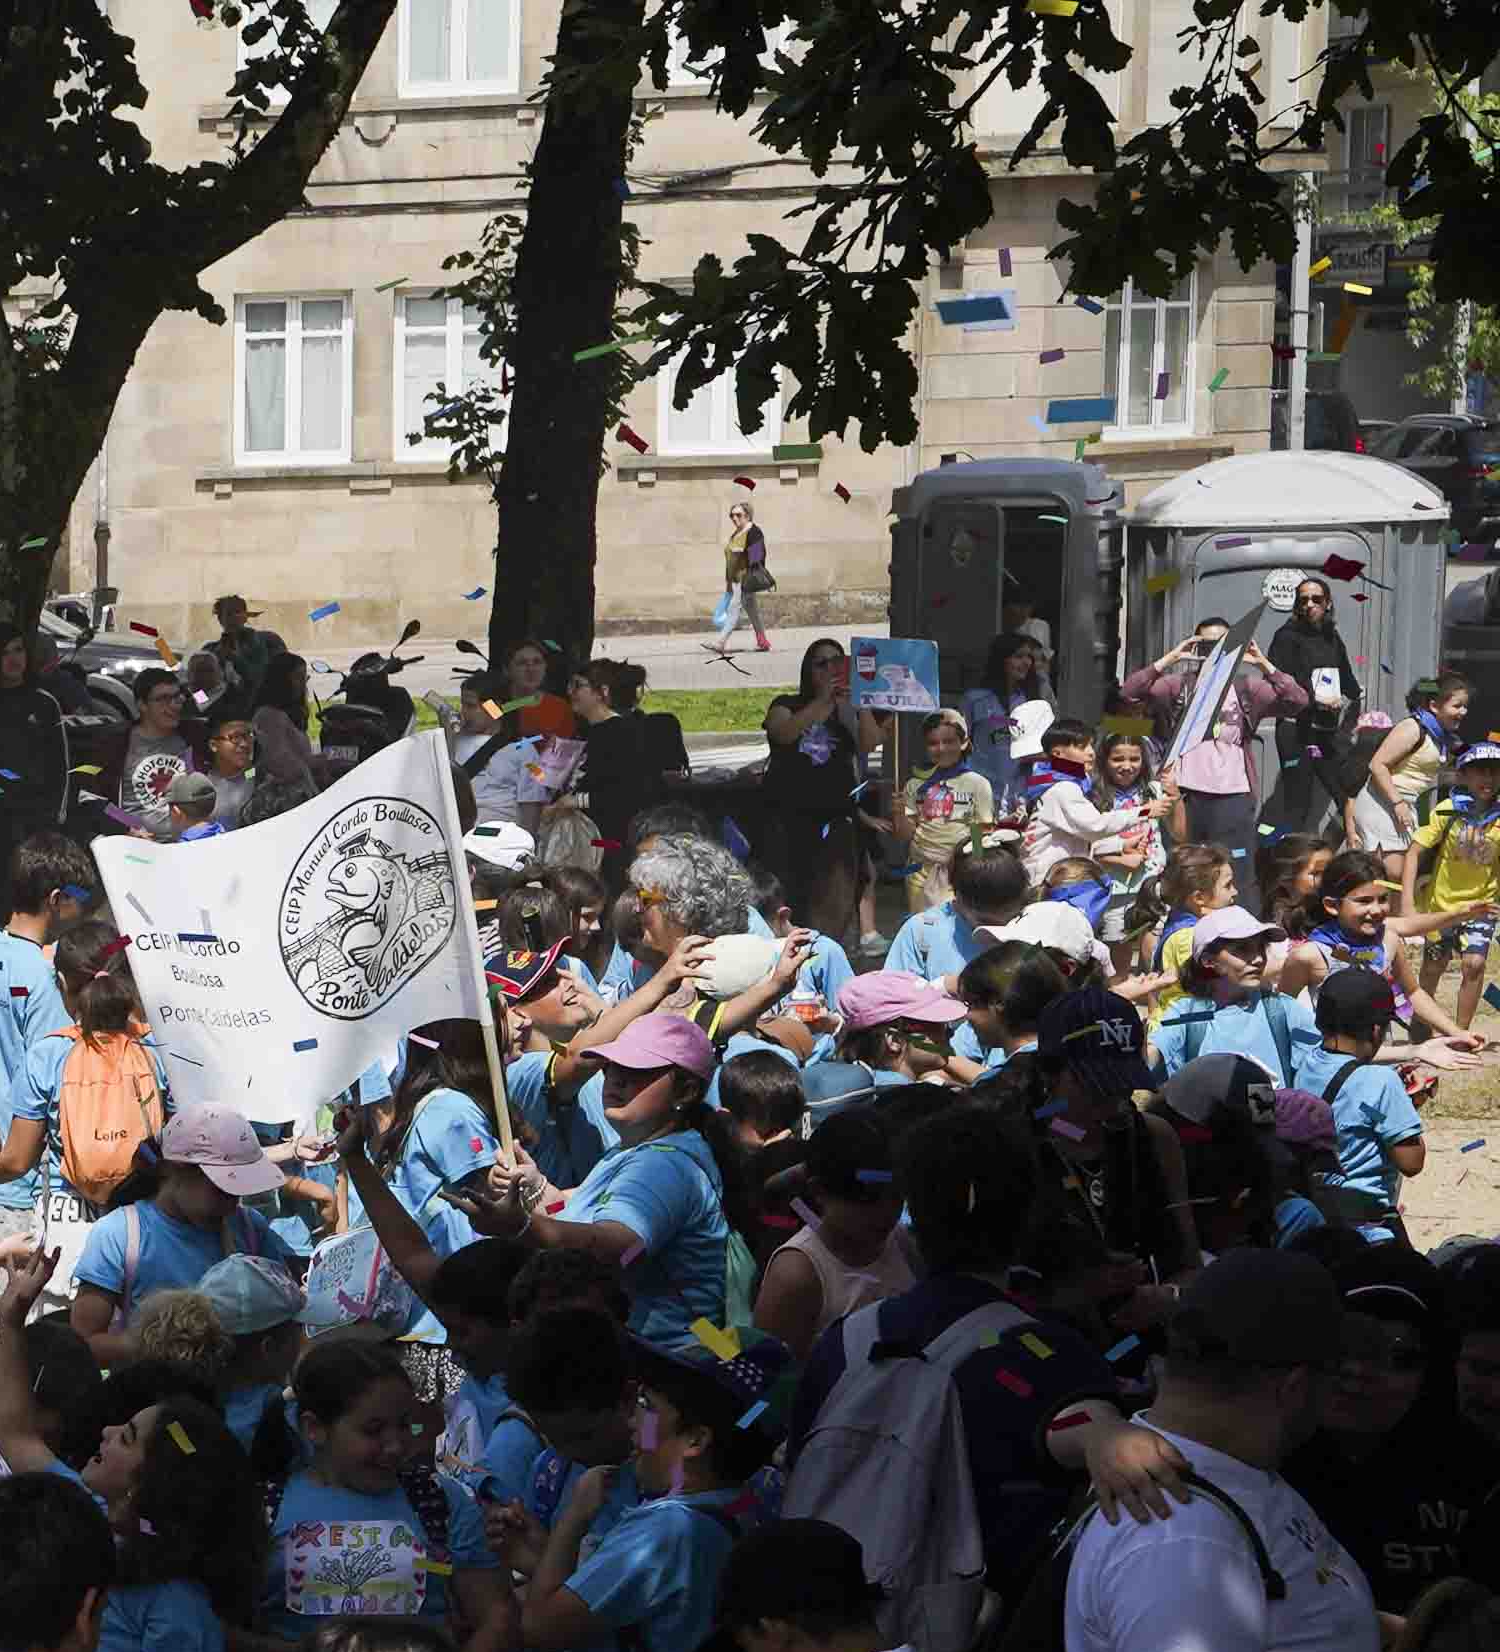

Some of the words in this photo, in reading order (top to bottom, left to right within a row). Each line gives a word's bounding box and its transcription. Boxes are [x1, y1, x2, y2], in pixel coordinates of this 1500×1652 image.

[1269, 584, 1293, 593] MAG
[332, 807, 369, 840] Cordo
[372, 802, 432, 835] Boullosa
[290, 834, 333, 896] Manuel
[285, 897, 301, 935] CEIP
[316, 981, 371, 1011] Ponte
[94, 1127, 129, 1142] Loire
[291, 1519, 414, 1549] XESTA
